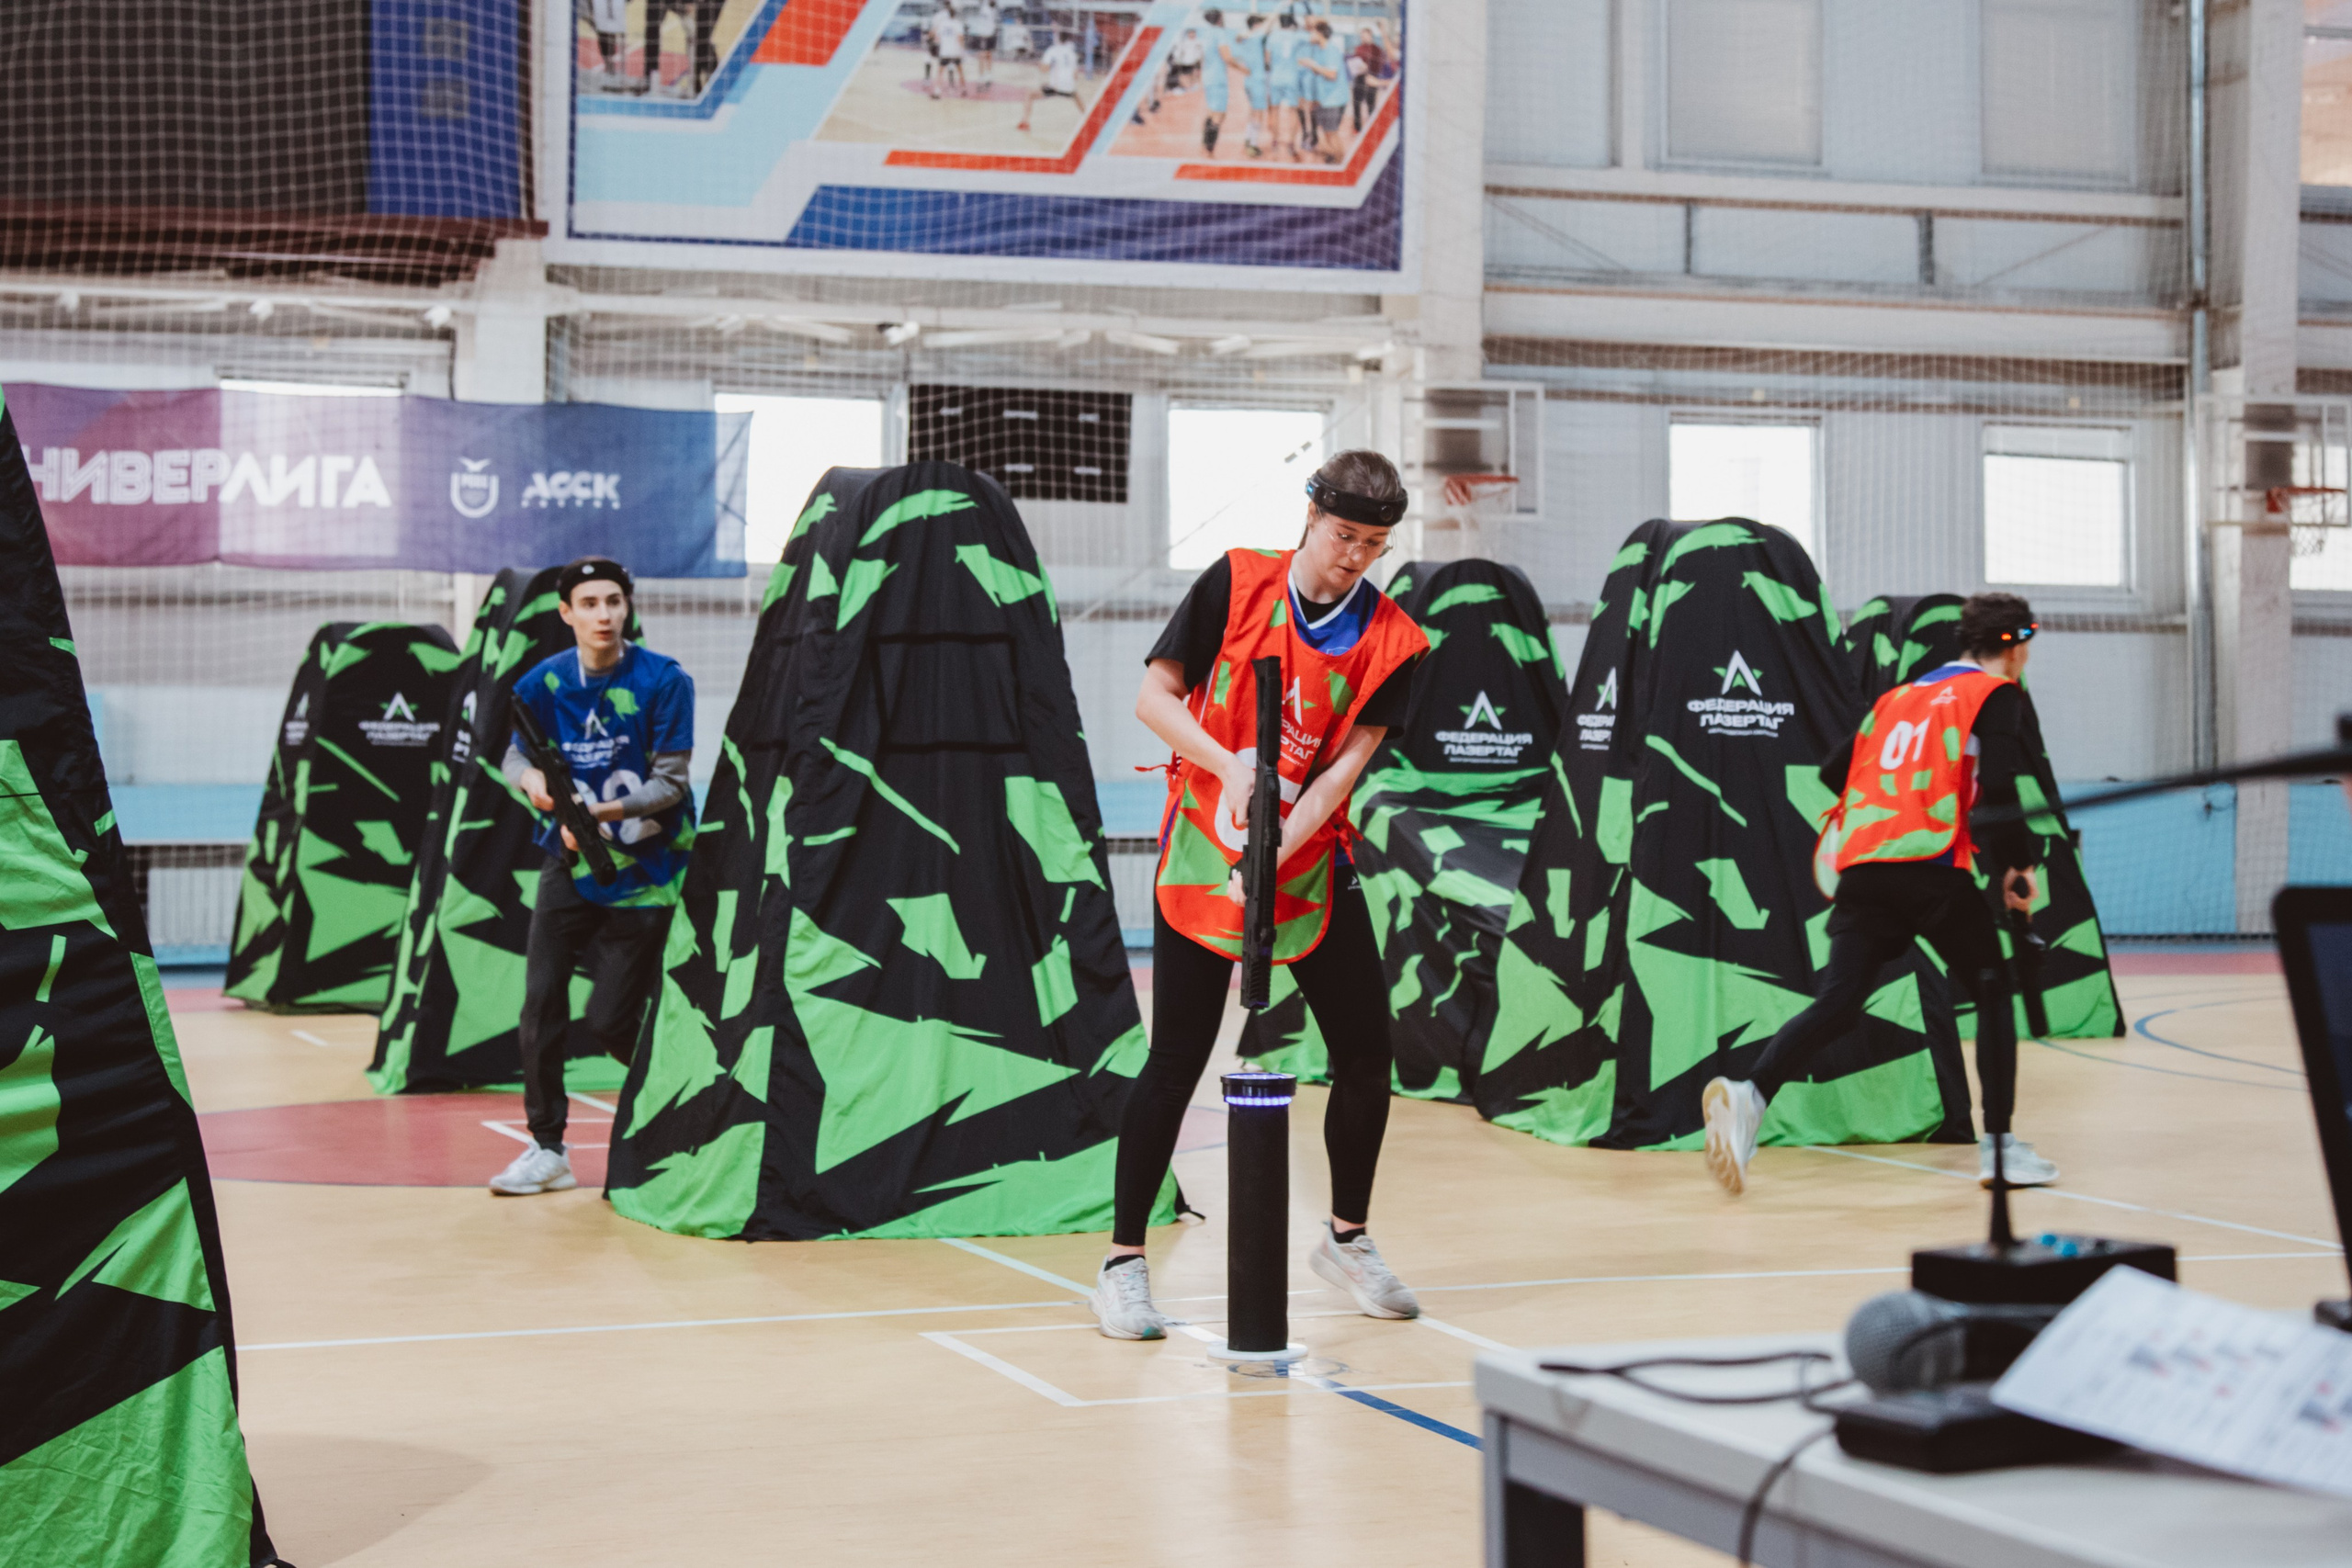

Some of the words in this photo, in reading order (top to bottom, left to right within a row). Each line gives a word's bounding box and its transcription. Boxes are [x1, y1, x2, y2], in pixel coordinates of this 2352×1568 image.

[21, 445, 392, 509] НИВЕРЛИГА
[1687, 697, 1795, 716] ФЕДЕРАЦИЯ
[1700, 713, 1784, 730] ЛАЗЕРТАГ
[1435, 730, 1533, 745] ФЕДЕРАЦИЯ
[1879, 716, 1930, 770] 01
[1444, 743, 1523, 757] ЛАЗЕРТАГ
